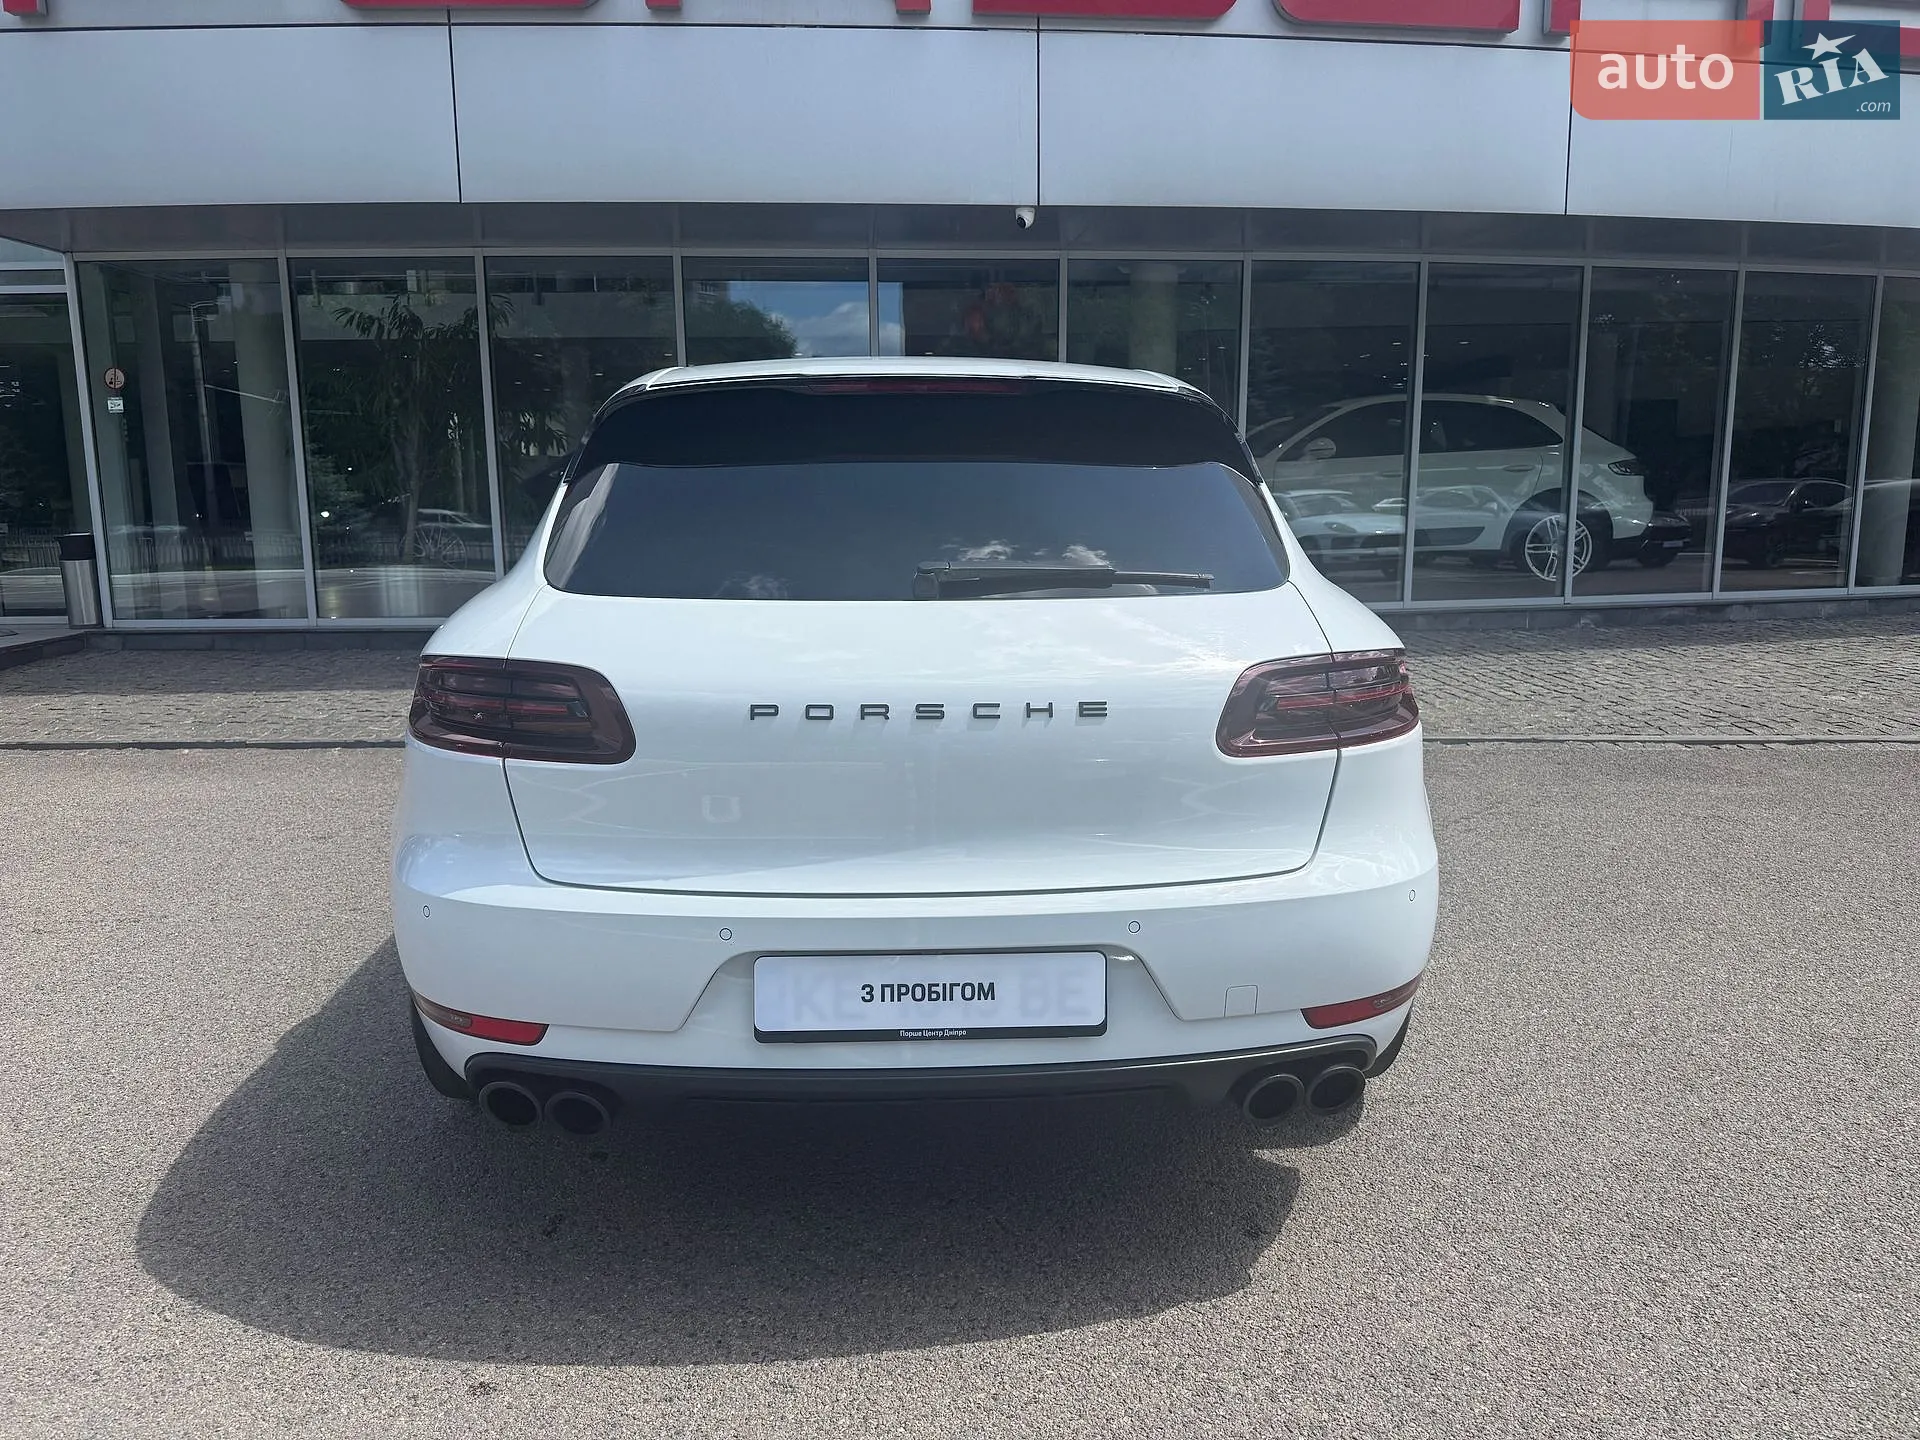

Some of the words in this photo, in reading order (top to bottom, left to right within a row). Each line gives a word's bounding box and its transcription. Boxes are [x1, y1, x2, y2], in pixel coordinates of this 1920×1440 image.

[749, 701, 1108, 721] PORSCHE
[880, 981, 996, 1003] ПРОБІГОМ
[899, 1029, 922, 1038] Порше
[923, 1029, 943, 1038] Центр
[944, 1028, 967, 1037] Дніпро
